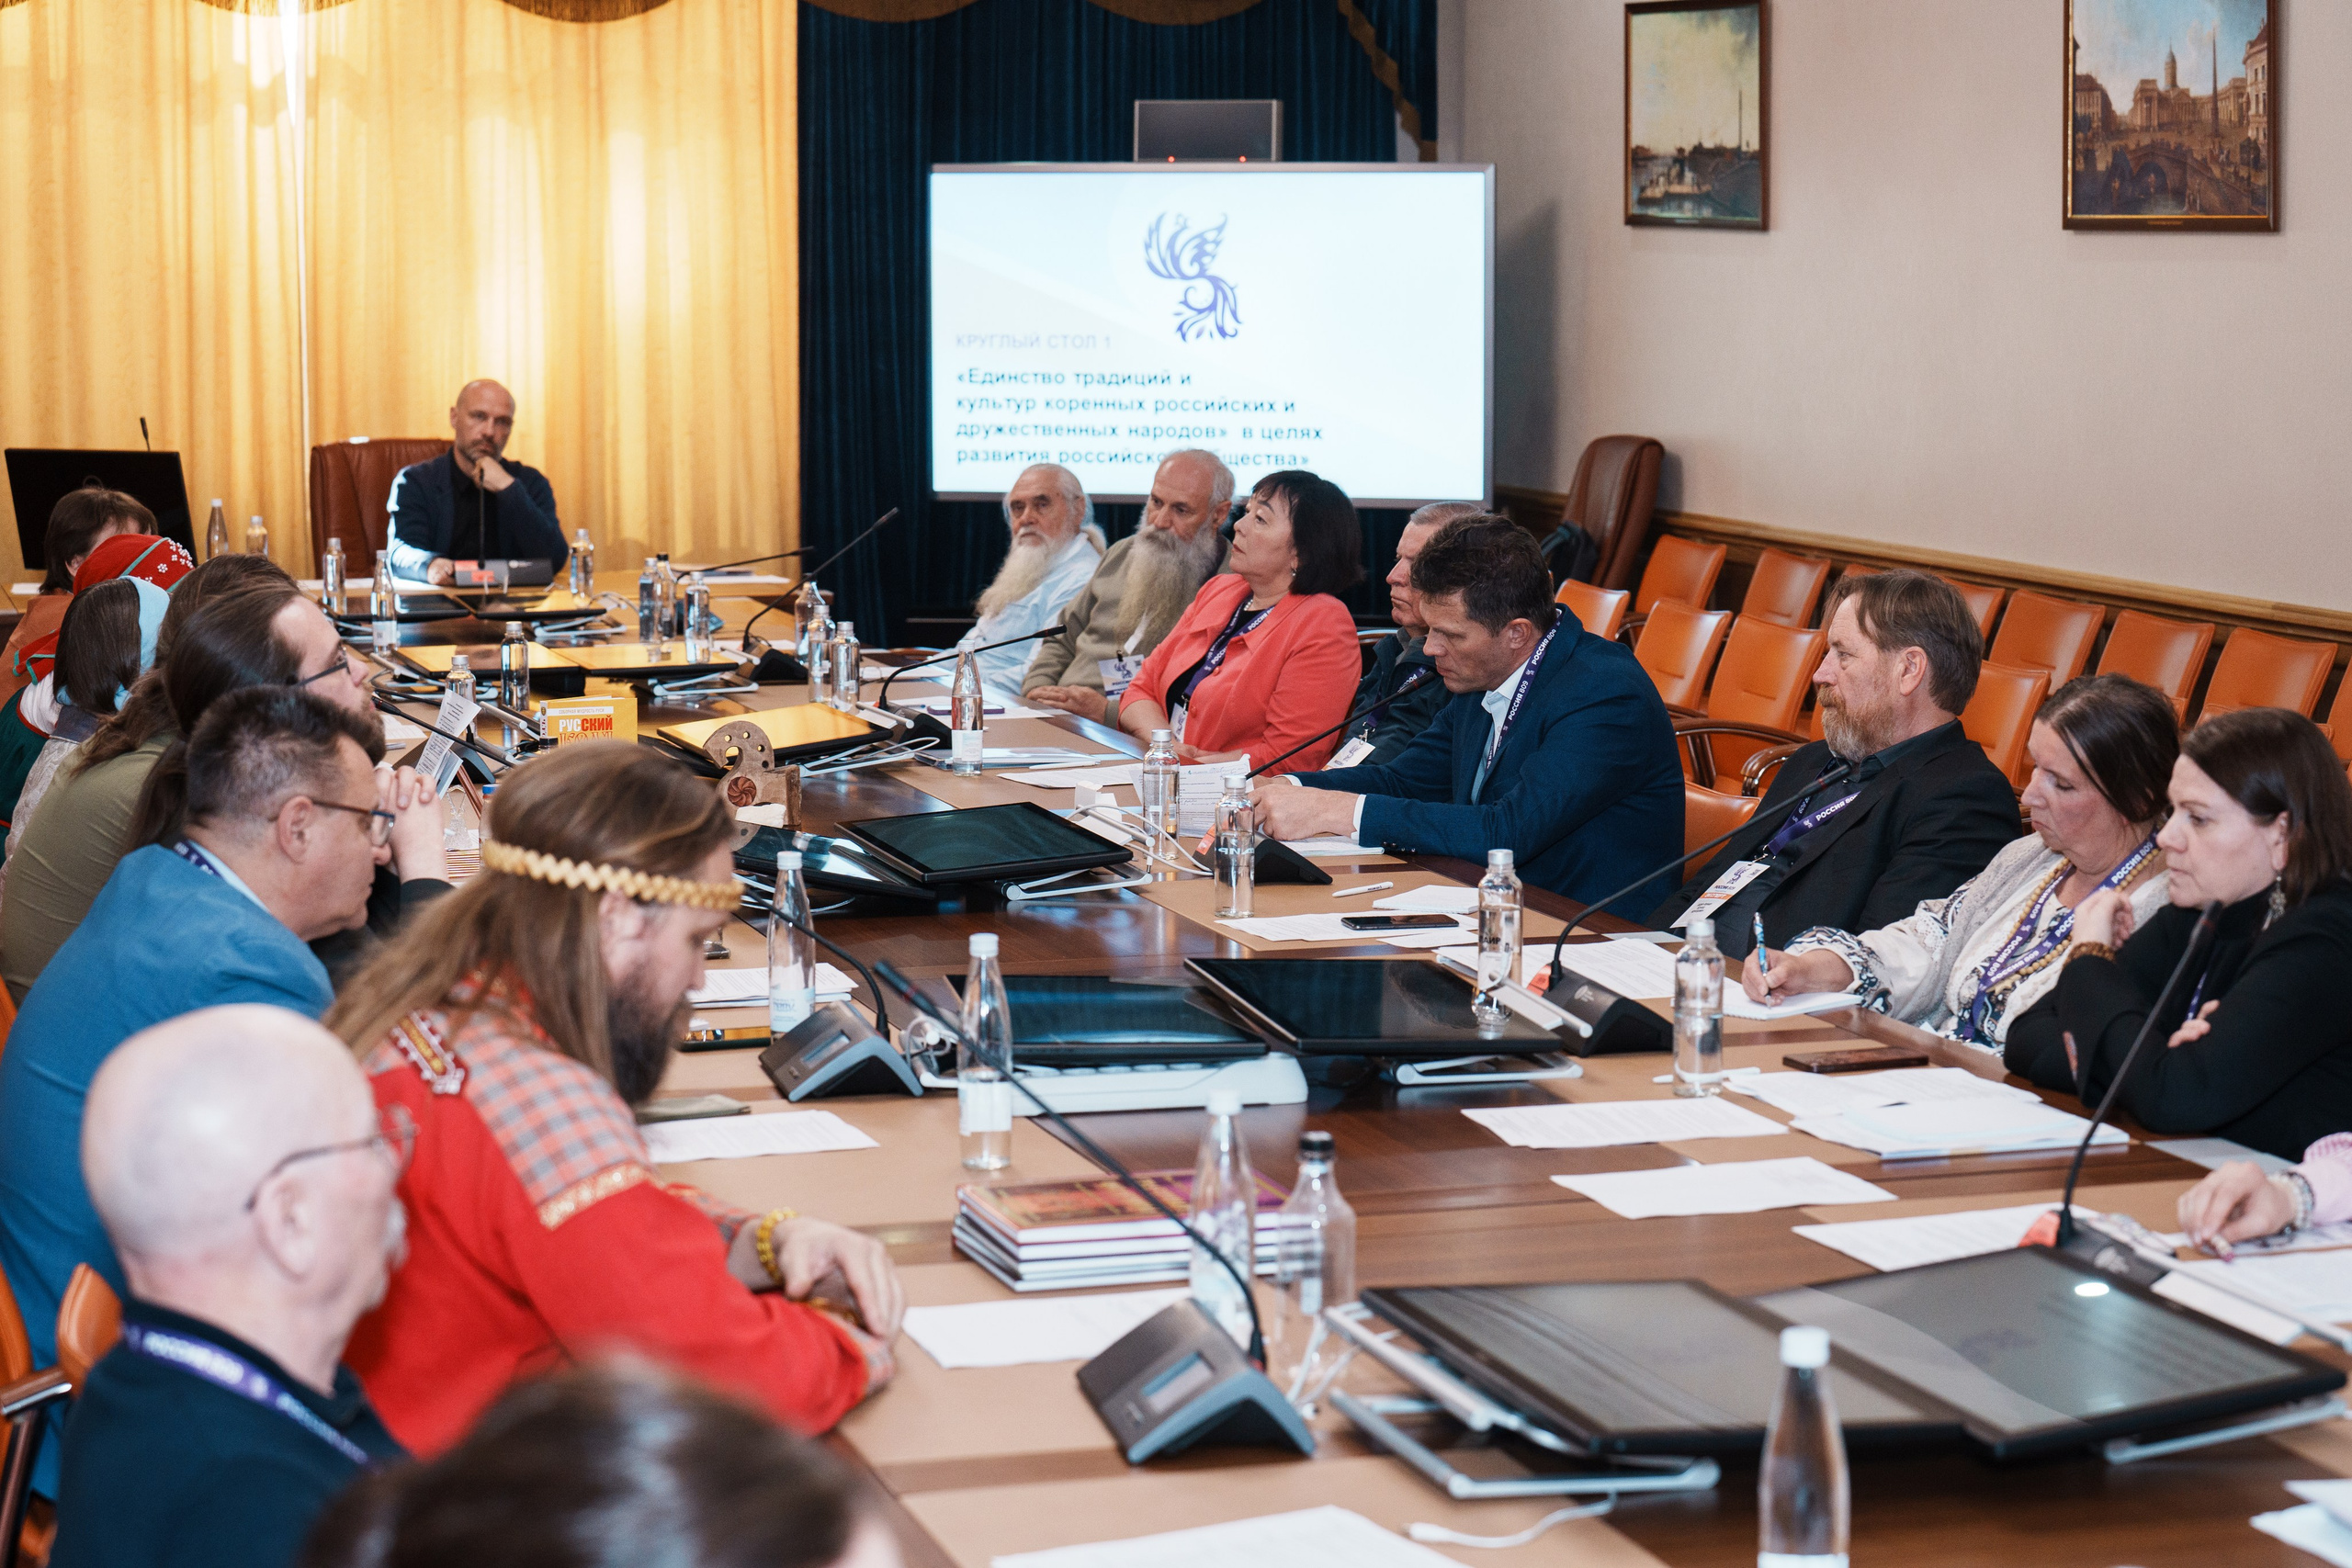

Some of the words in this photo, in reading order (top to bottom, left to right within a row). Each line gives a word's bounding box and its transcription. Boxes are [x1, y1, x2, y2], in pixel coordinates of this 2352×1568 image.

[956, 333, 1041, 349] КРУГЛЫЙ
[1047, 334, 1097, 349] СТОЛ
[1104, 335, 1112, 349] 1
[957, 367, 1066, 385] «Единство
[1075, 369, 1170, 388] традиций
[1182, 374, 1192, 385] и
[956, 397, 1036, 413] культур
[1046, 397, 1146, 413] коренных
[1155, 396, 1276, 413] российских
[1284, 400, 1295, 412] и
[956, 423, 1118, 439] дружественных
[1129, 425, 1227, 440] народов»
[1243, 427, 1253, 438] в
[1261, 427, 1323, 441] целях
[957, 449, 1050, 465] развития
[1059, 447, 1166, 464] российско
[1210, 646, 1227, 665] РОСС
[1532, 638, 1550, 666] РОССИЯ
[1508, 693, 1524, 721] РОССИЯ
[1519, 680, 1529, 694] 809
[559, 715, 613, 732] РУССКИЙ
[1815, 800, 1846, 821] РОССИЯ
[2110, 854, 2143, 885] РОССИЯ
[2054, 914, 2075, 938] РОСС
[1999, 935, 2022, 964] РОССИЯ
[1987, 962, 2001, 977] 809
[1990, 959, 2024, 982] РОССИЯ
